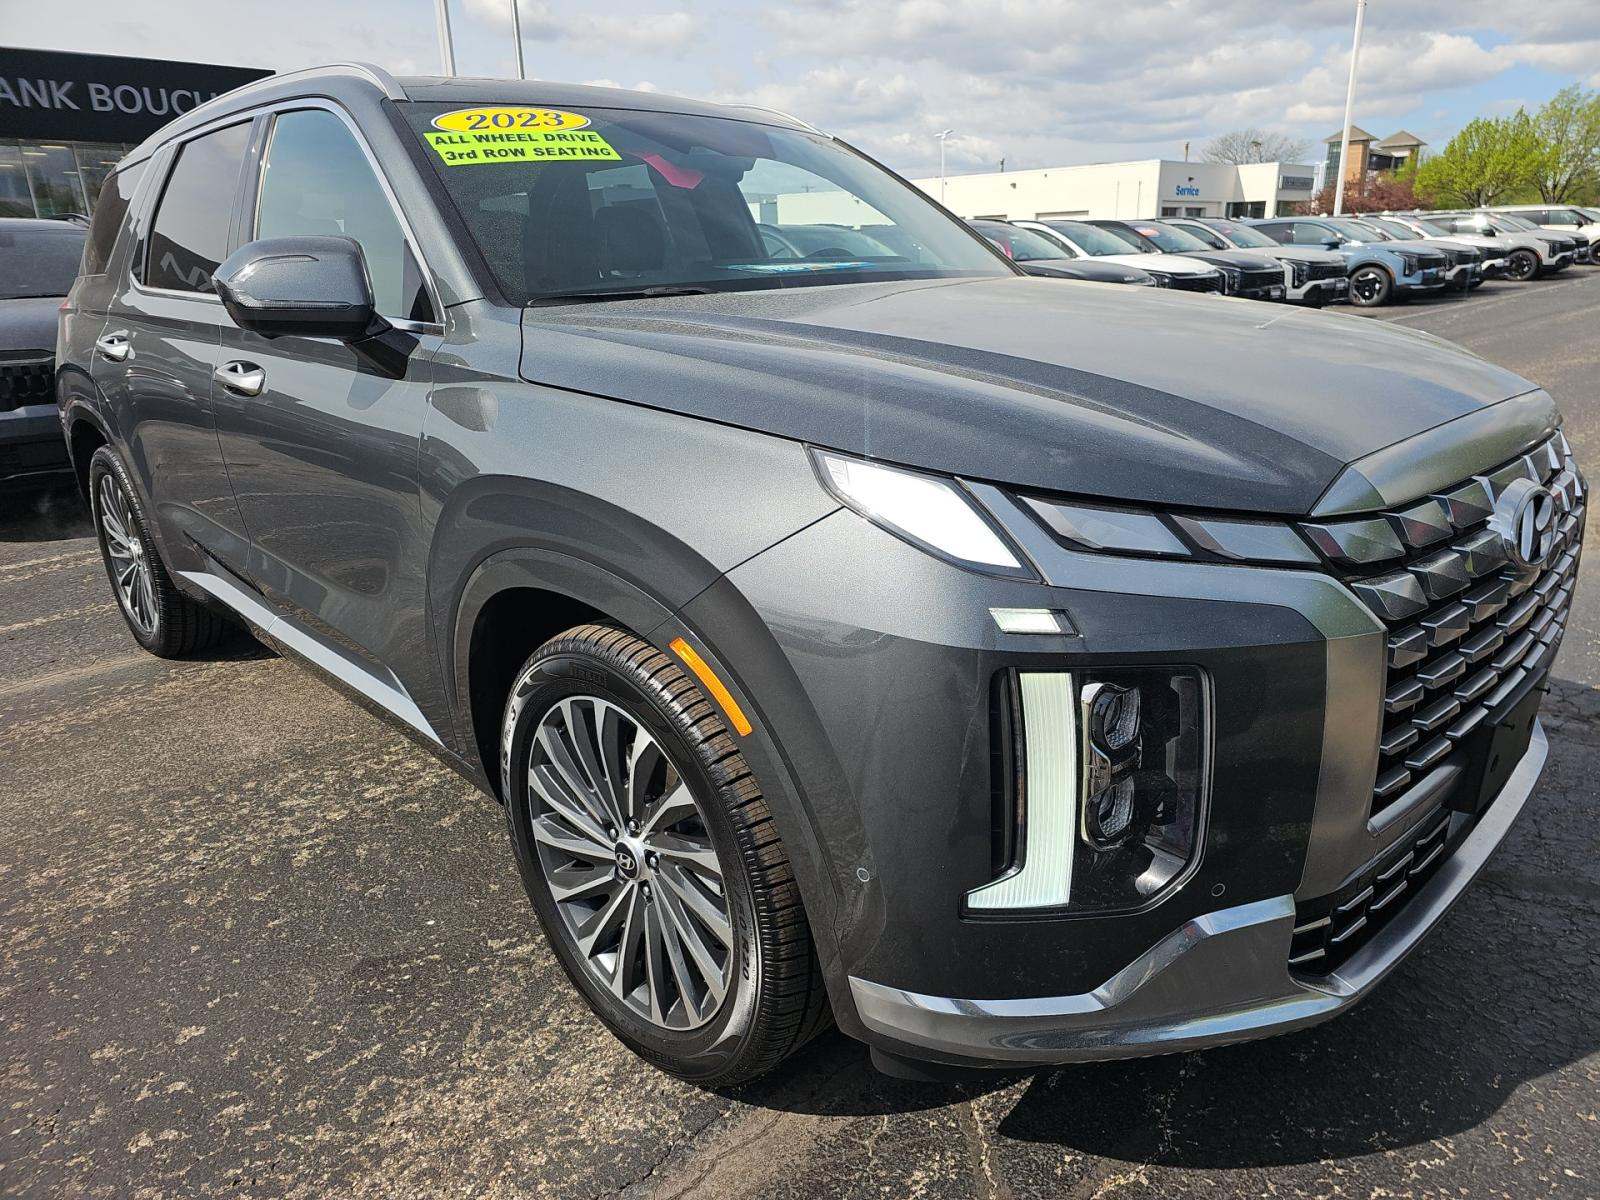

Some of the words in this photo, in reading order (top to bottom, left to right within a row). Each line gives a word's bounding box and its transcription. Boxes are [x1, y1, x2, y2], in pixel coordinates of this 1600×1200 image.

[465, 112, 564, 130] 2023
[435, 135, 470, 145] ALL
[473, 133, 538, 143] WHEEL
[543, 133, 600, 143] DRIVE
[445, 149, 478, 161] 3rd
[482, 148, 526, 158] ROW
[533, 147, 611, 156] SEATING
[1175, 184, 1200, 197] Service
